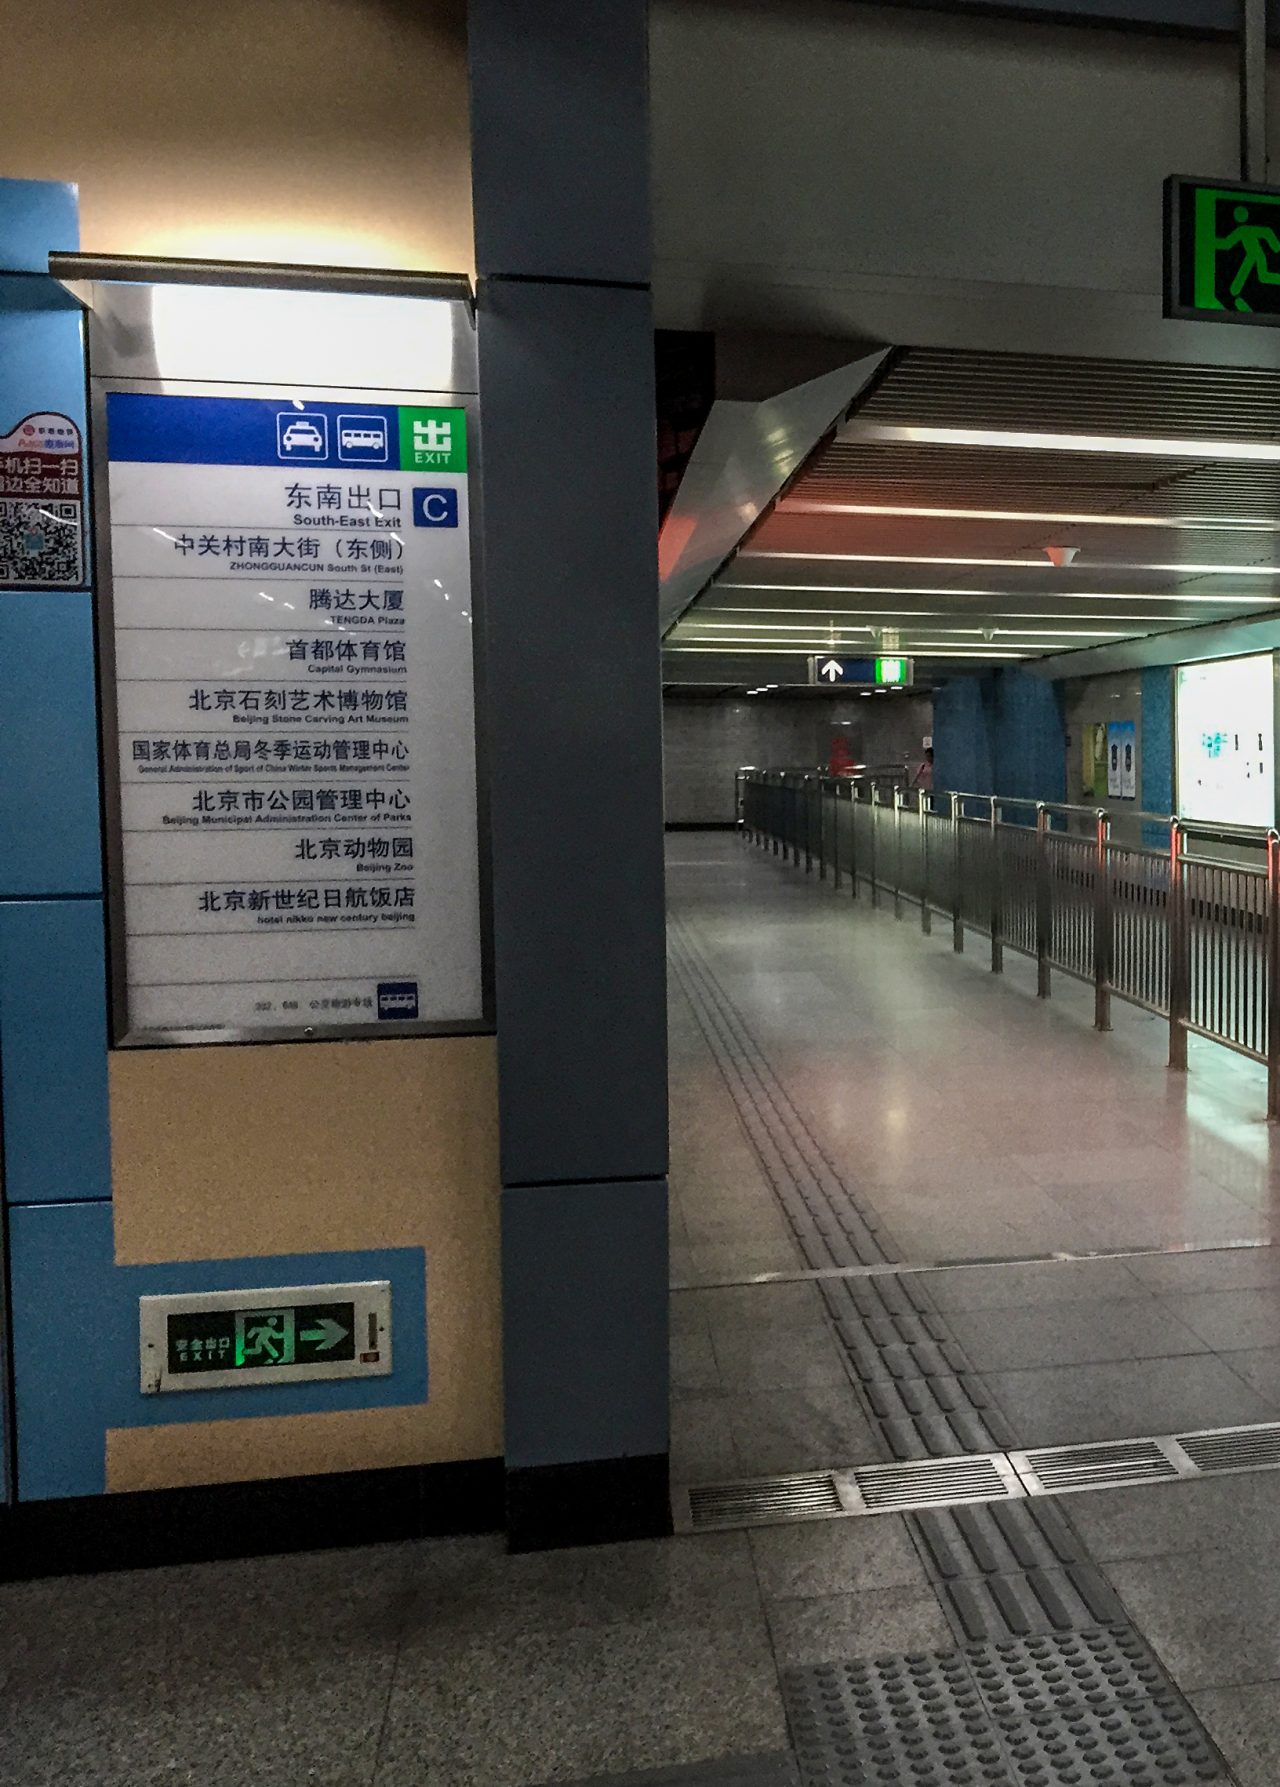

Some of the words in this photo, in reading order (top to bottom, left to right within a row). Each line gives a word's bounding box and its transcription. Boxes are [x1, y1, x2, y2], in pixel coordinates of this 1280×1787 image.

[0, 457, 79, 476] 机扫一扫
[414, 452, 452, 464] EXIT
[285, 482, 401, 511] 东南出口
[422, 494, 448, 522] C
[293, 514, 370, 528] South-East
[374, 515, 402, 528] Exit
[229, 561, 325, 573] ZHONGGUANCUN
[327, 563, 358, 573] South
[361, 564, 371, 573] St
[374, 565, 404, 576] (East)
[309, 588, 405, 612] 腾达大厦
[330, 615, 375, 625] TENGDA
[378, 617, 406, 625] Plaza
[286, 639, 406, 662] 首都体育馆
[307, 664, 344, 675] Capital
[346, 664, 408, 675] Gymnasium
[188, 689, 409, 712] 北京石刻艺术博物馆
[232, 714, 269, 725] Beijing
[272, 714, 302, 723] Stone
[304, 714, 345, 725] Carving
[347, 714, 363, 723] Art
[366, 714, 409, 724] Museum
[132, 739, 410, 761] 国家体育总局冬季运动管理中心
[192, 788, 411, 811] 北京市公园管理中心
[162, 815, 199, 826] Beijing
[202, 815, 253, 825] Municipal
[255, 814, 331, 824] Administration
[334, 813, 368, 822] Center
[370, 813, 382, 821] of
[384, 813, 412, 821] Parks
[295, 837, 413, 859] 北京动物园
[356, 863, 391, 873] Beijing
[394, 863, 414, 871] Zoo
[198, 886, 415, 912] 北京新世纪日航饭店
[257, 915, 283, 924] hotel
